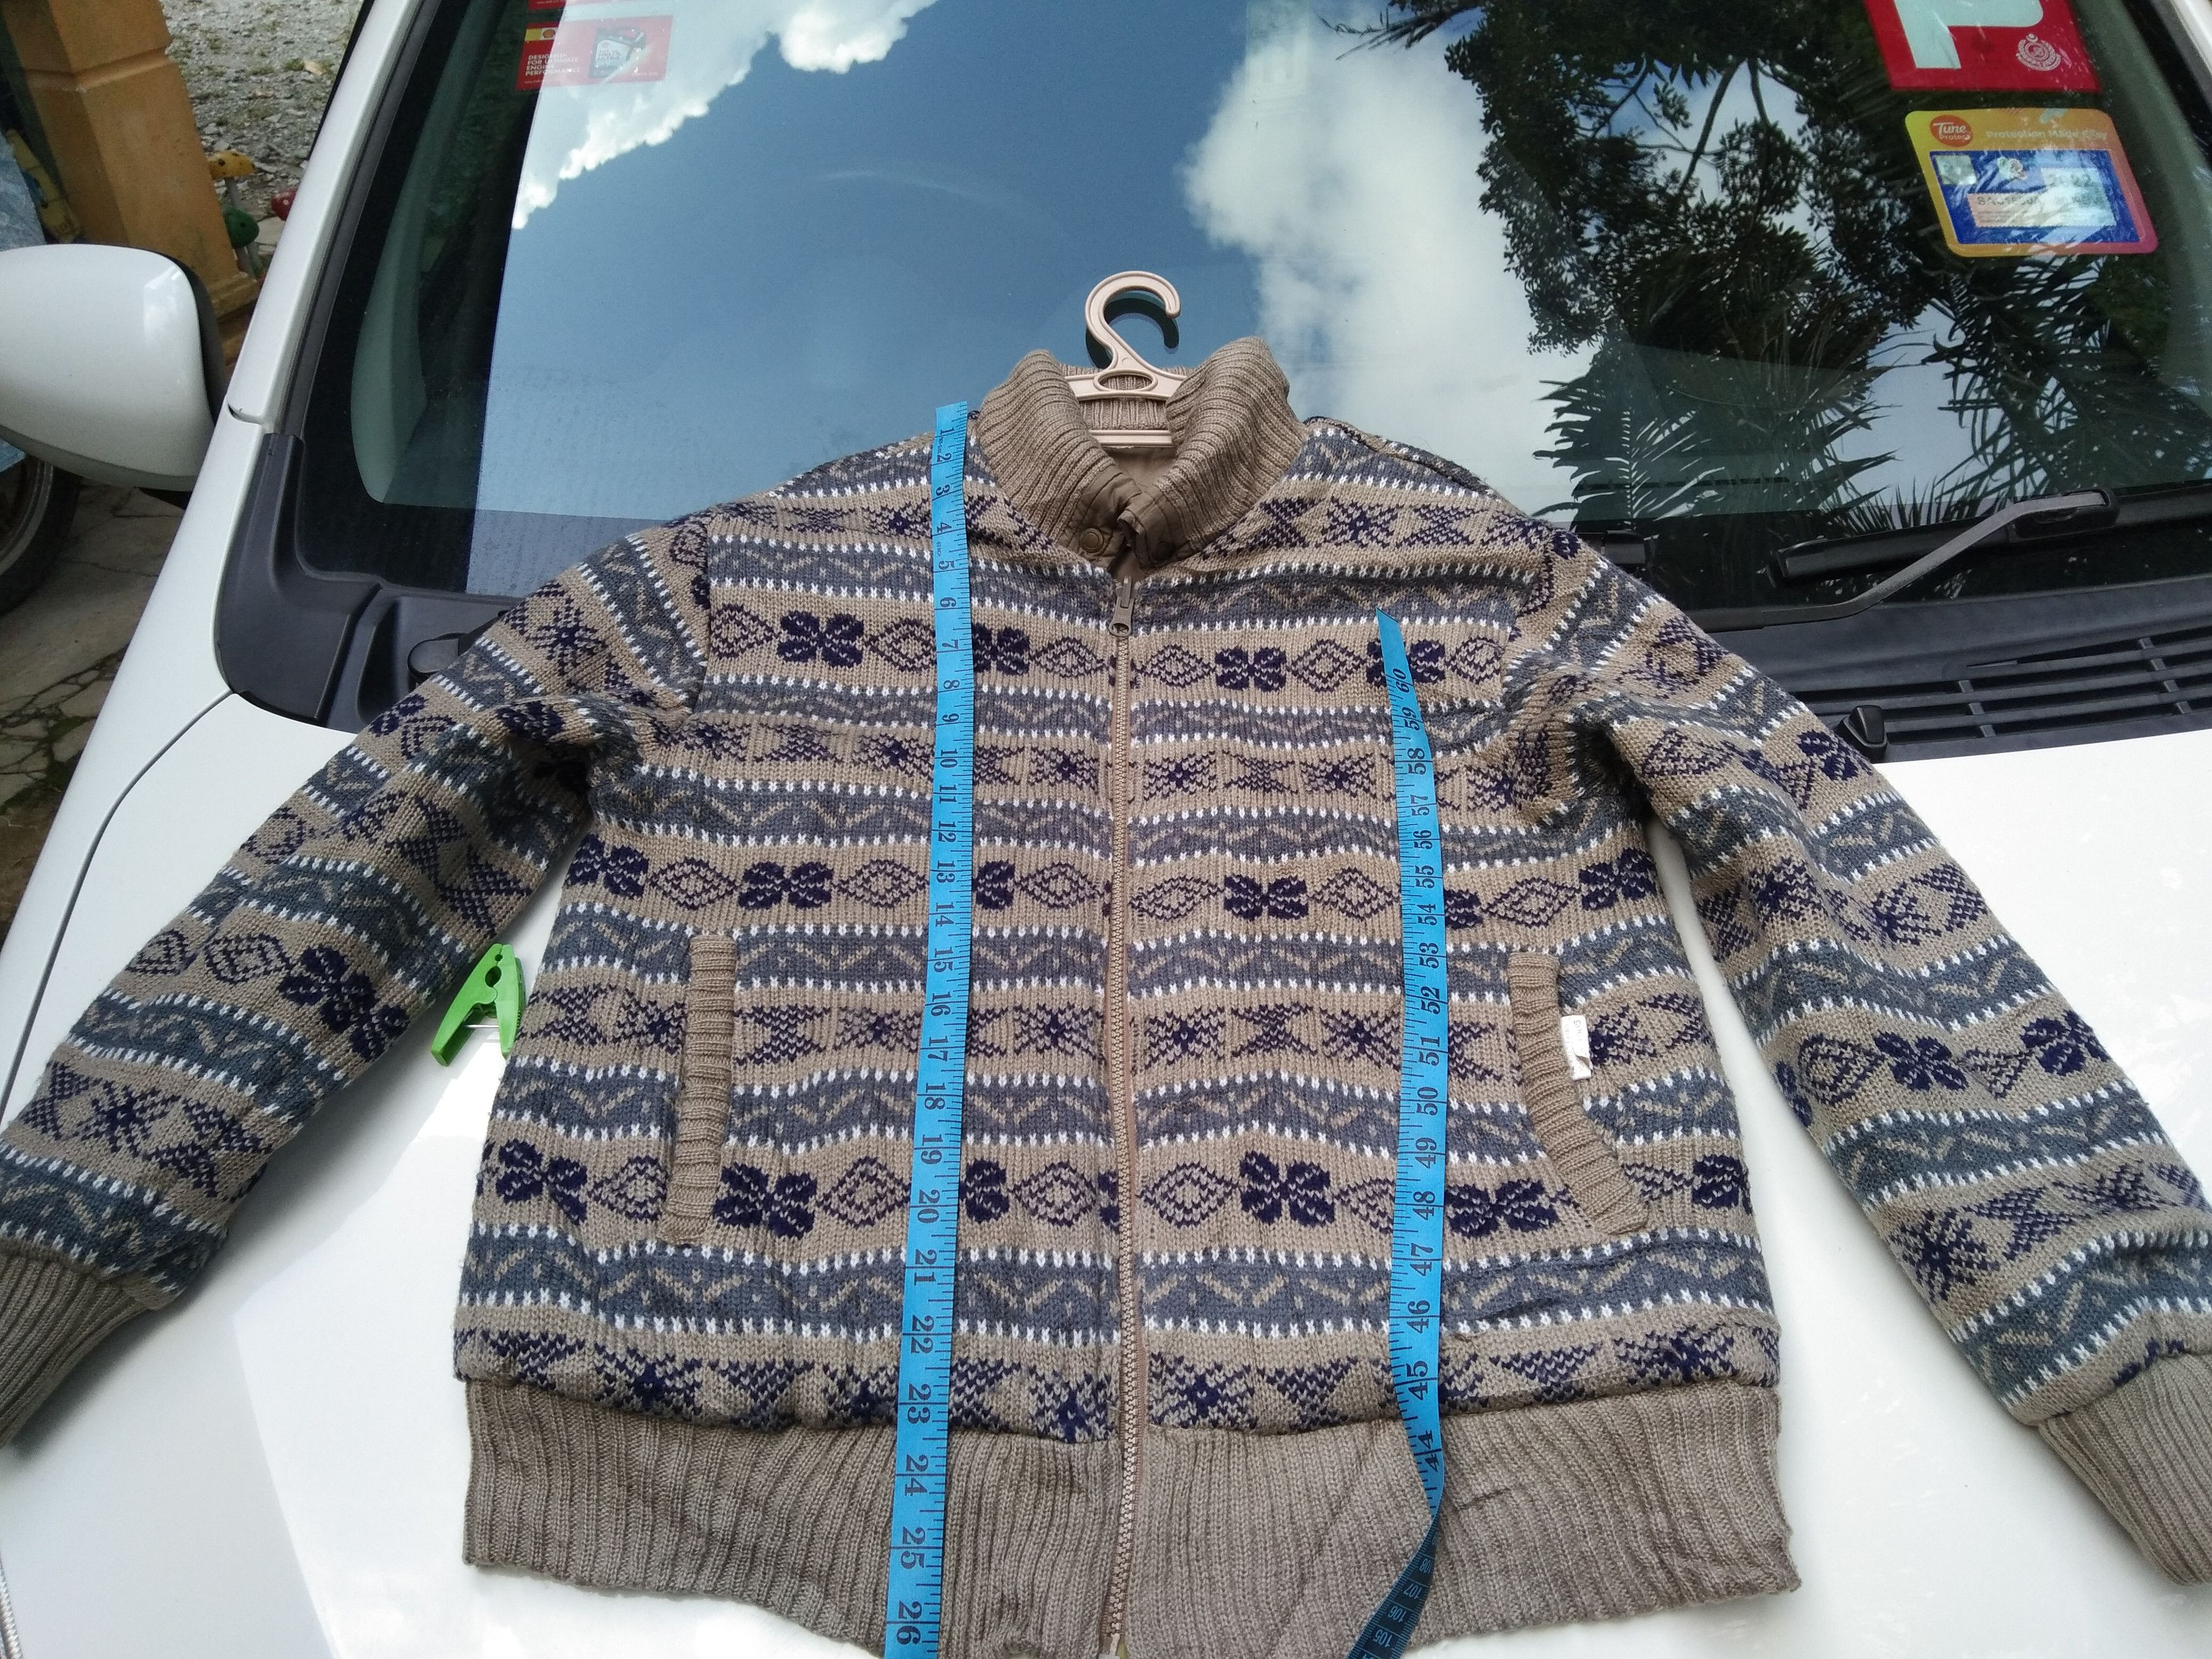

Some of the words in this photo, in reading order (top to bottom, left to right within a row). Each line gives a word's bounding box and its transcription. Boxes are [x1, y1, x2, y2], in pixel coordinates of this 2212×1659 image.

[1932, 121, 1966, 134] Tune
[940, 427, 954, 435] 1
[937, 452, 952, 463] 2
[935, 484, 951, 496] 3
[936, 522, 952, 533] 4
[938, 560, 955, 570] 5
[939, 597, 957, 609] 6
[940, 638, 959, 650] 7
[942, 679, 961, 690] 8
[1392, 668, 1409, 693] 60
[941, 712, 959, 724] 9
[1401, 706, 1420, 731] 59
[939, 748, 959, 769] 10
[1406, 747, 1426, 776] 58
[938, 784, 958, 804] 11
[1409, 794, 1430, 817] 57
[937, 820, 956, 843] 12
[1413, 829, 1432, 850] 56
[935, 860, 954, 884] 13
[1414, 865, 1435, 889] 55
[934, 901, 954, 927] 14
[1417, 903, 1437, 927] 54
[933, 947, 954, 973] 15
[1418, 942, 1439, 969] 53
[930, 992, 951, 1017] 16
[1419, 985, 1440, 1015] 52
[927, 1035, 949, 1061] 17
[1418, 1036, 1440, 1067] 51
[924, 1082, 946, 1110] 18
[1416, 1086, 1439, 1116] 50
[920, 1133, 943, 1165] 19
[1414, 1136, 1437, 1169] 49
[916, 1189, 942, 1224] 20
[1413, 1190, 1435, 1221] 48
[913, 1249, 939, 1286] 21
[1410, 1243, 1433, 1277] 47
[1406, 1300, 1431, 1334] 46
[910, 1315, 935, 1354] 22
[1405, 1360, 1430, 1401] 45
[906, 1383, 932, 1425] 23
[1416, 1430, 1439, 1473] 44
[904, 1454, 929, 1497] 24
[900, 1526, 926, 1570] 25
[1404, 1583, 1423, 1599] 107
[896, 1601, 923, 1646] 26
[1388, 1606, 1407, 1623] 106
[1373, 1629, 1393, 1648] 105
